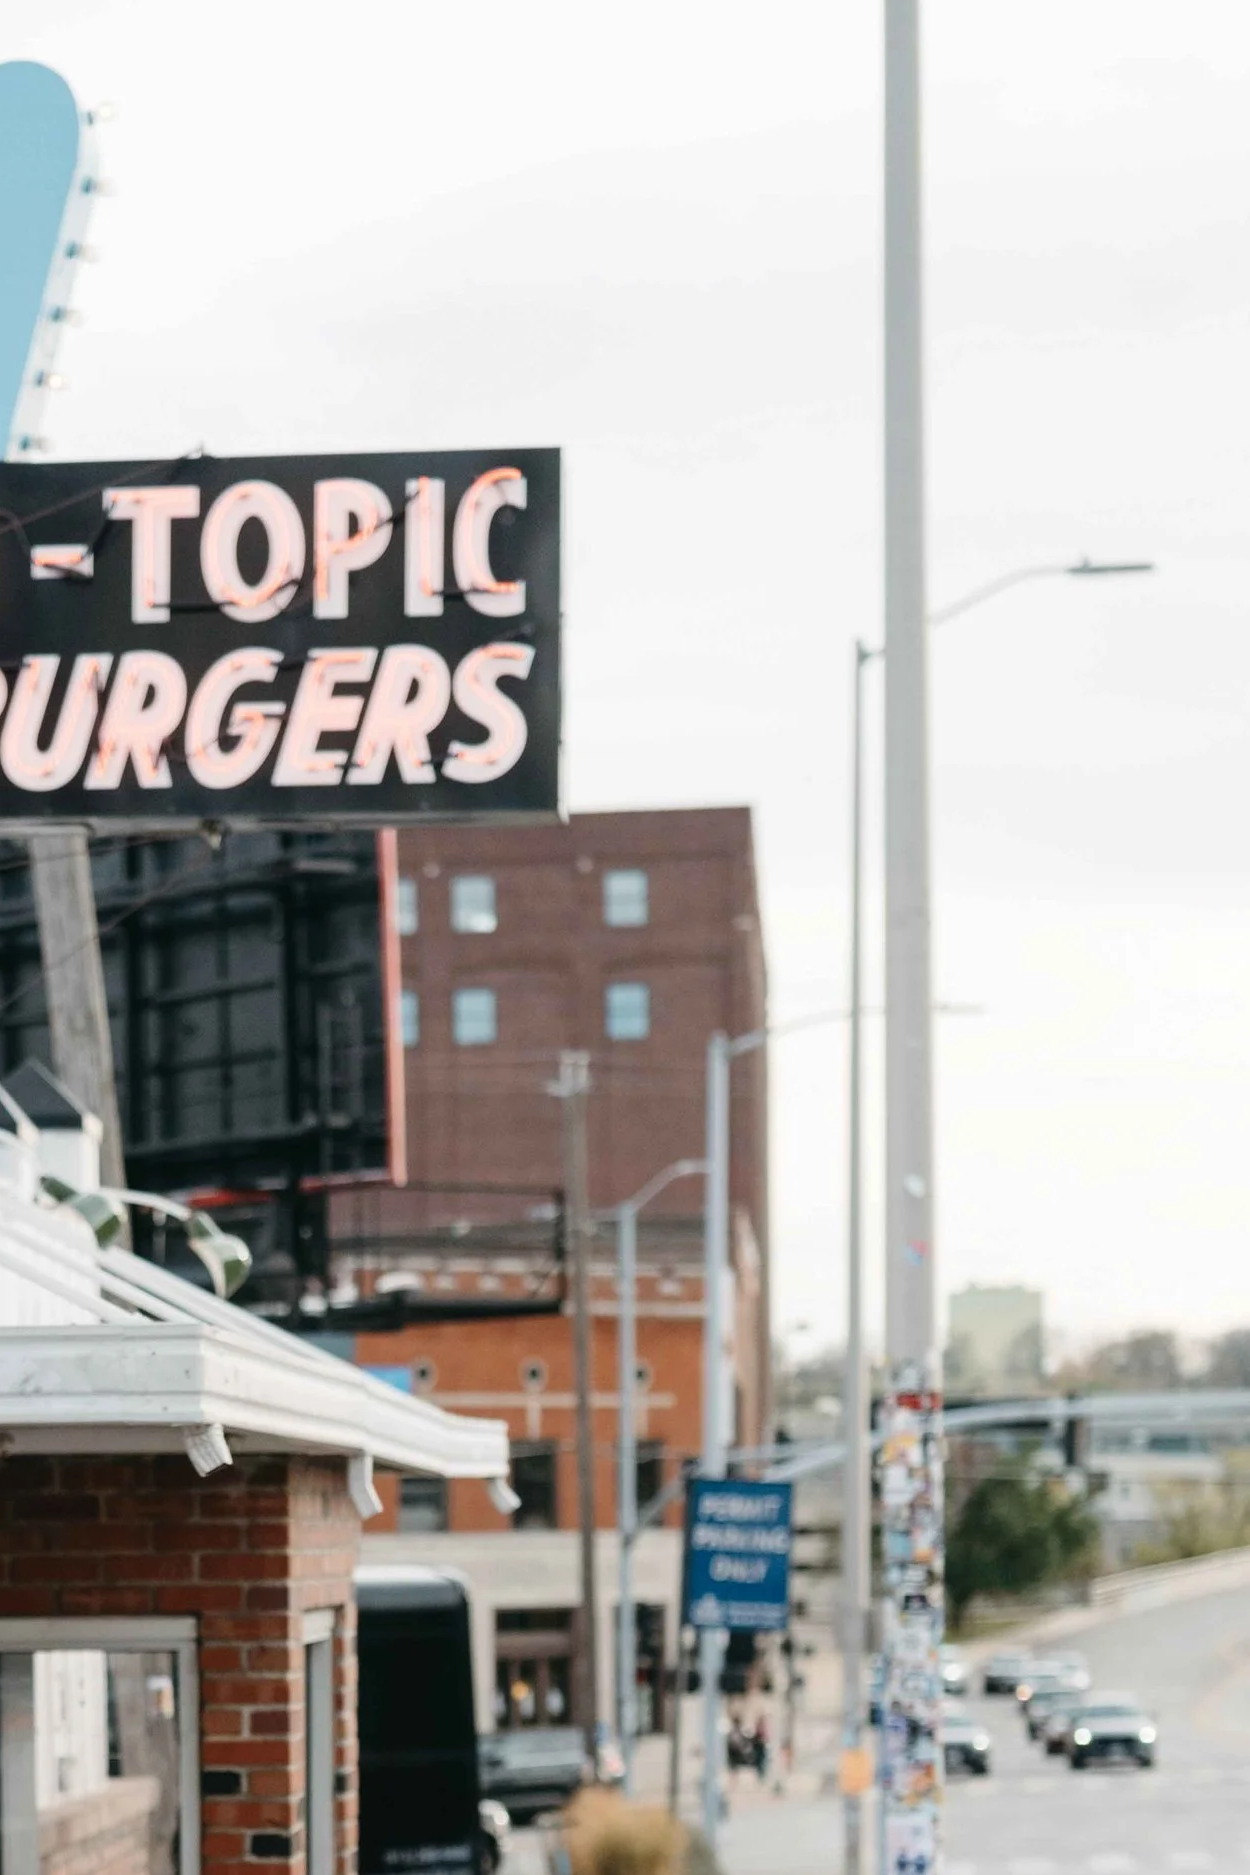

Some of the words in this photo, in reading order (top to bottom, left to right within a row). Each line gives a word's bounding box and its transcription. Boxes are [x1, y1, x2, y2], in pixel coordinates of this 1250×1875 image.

[698, 1492, 783, 1522] PERMIT
[692, 1523, 790, 1554] PARKING
[710, 1555, 768, 1584] ONLY
